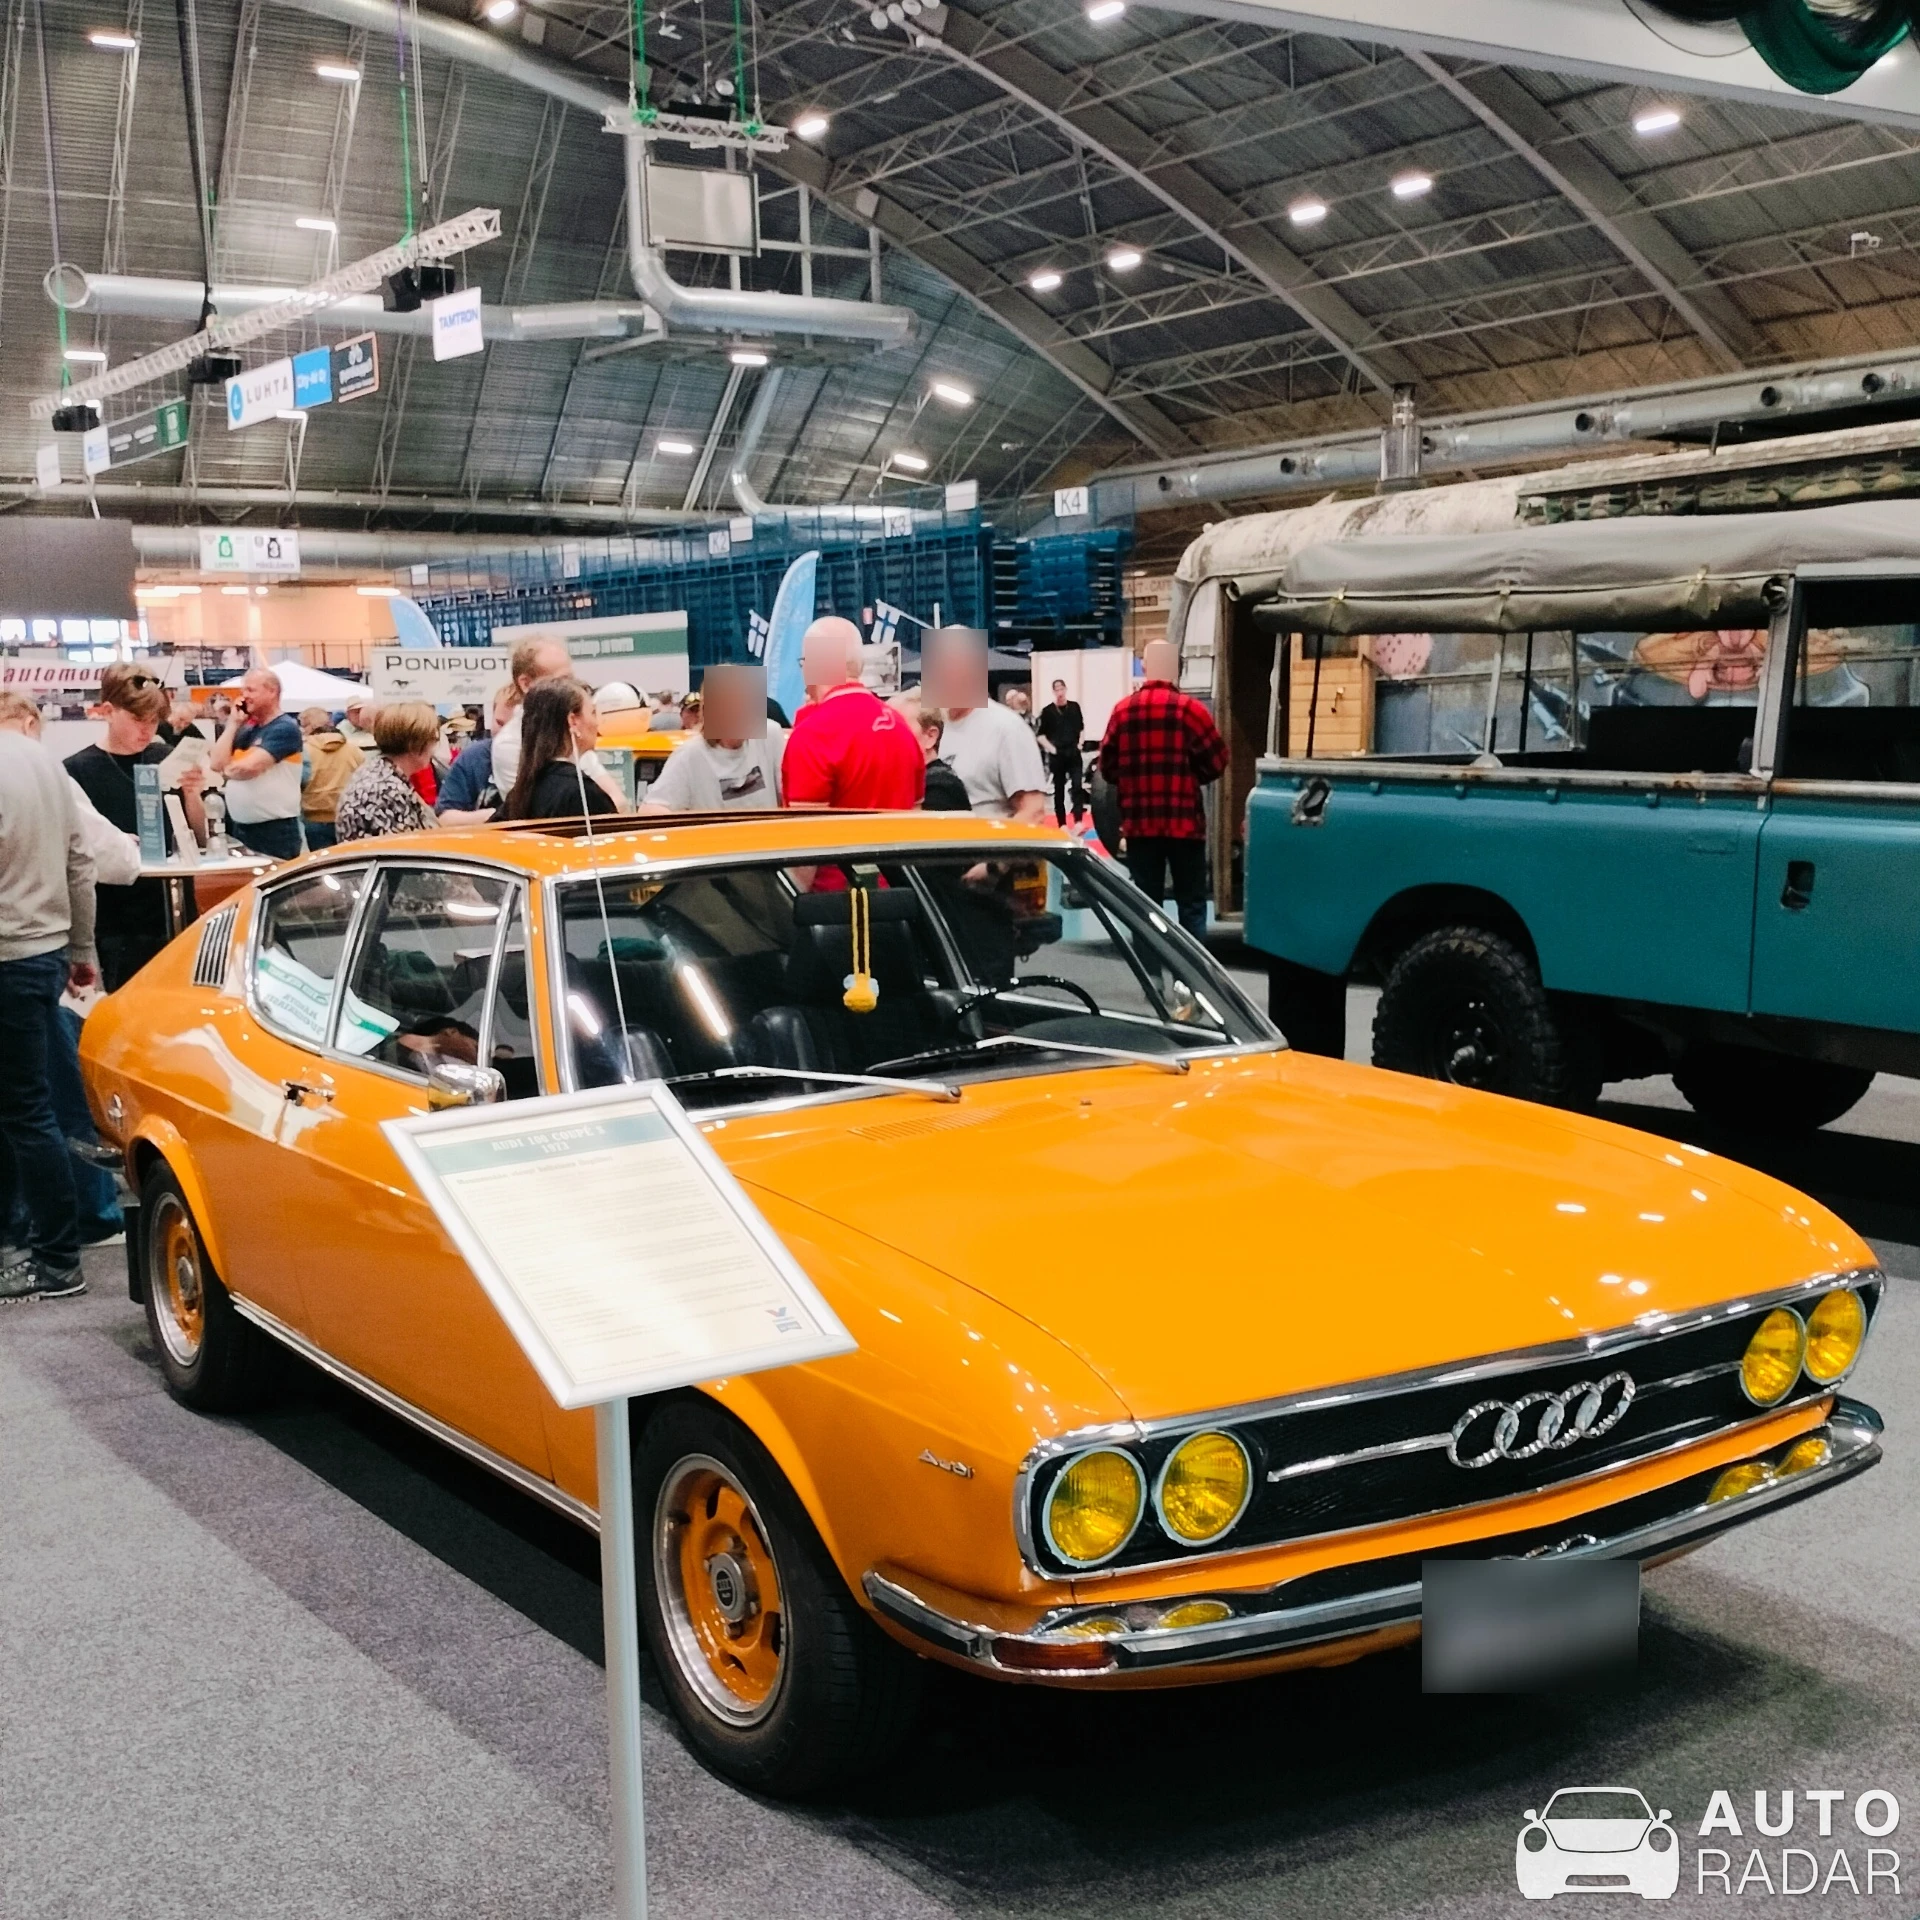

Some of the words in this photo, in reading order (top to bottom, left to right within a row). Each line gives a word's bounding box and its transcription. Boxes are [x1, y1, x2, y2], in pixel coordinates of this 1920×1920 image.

[246, 376, 290, 405] LUHTA
[1061, 491, 1082, 513] K4
[890, 516, 907, 536] K3
[713, 535, 728, 550] K2
[492, 1138, 523, 1151] AUDI
[528, 1134, 550, 1146] 100
[551, 1124, 594, 1142] COUPÉ
